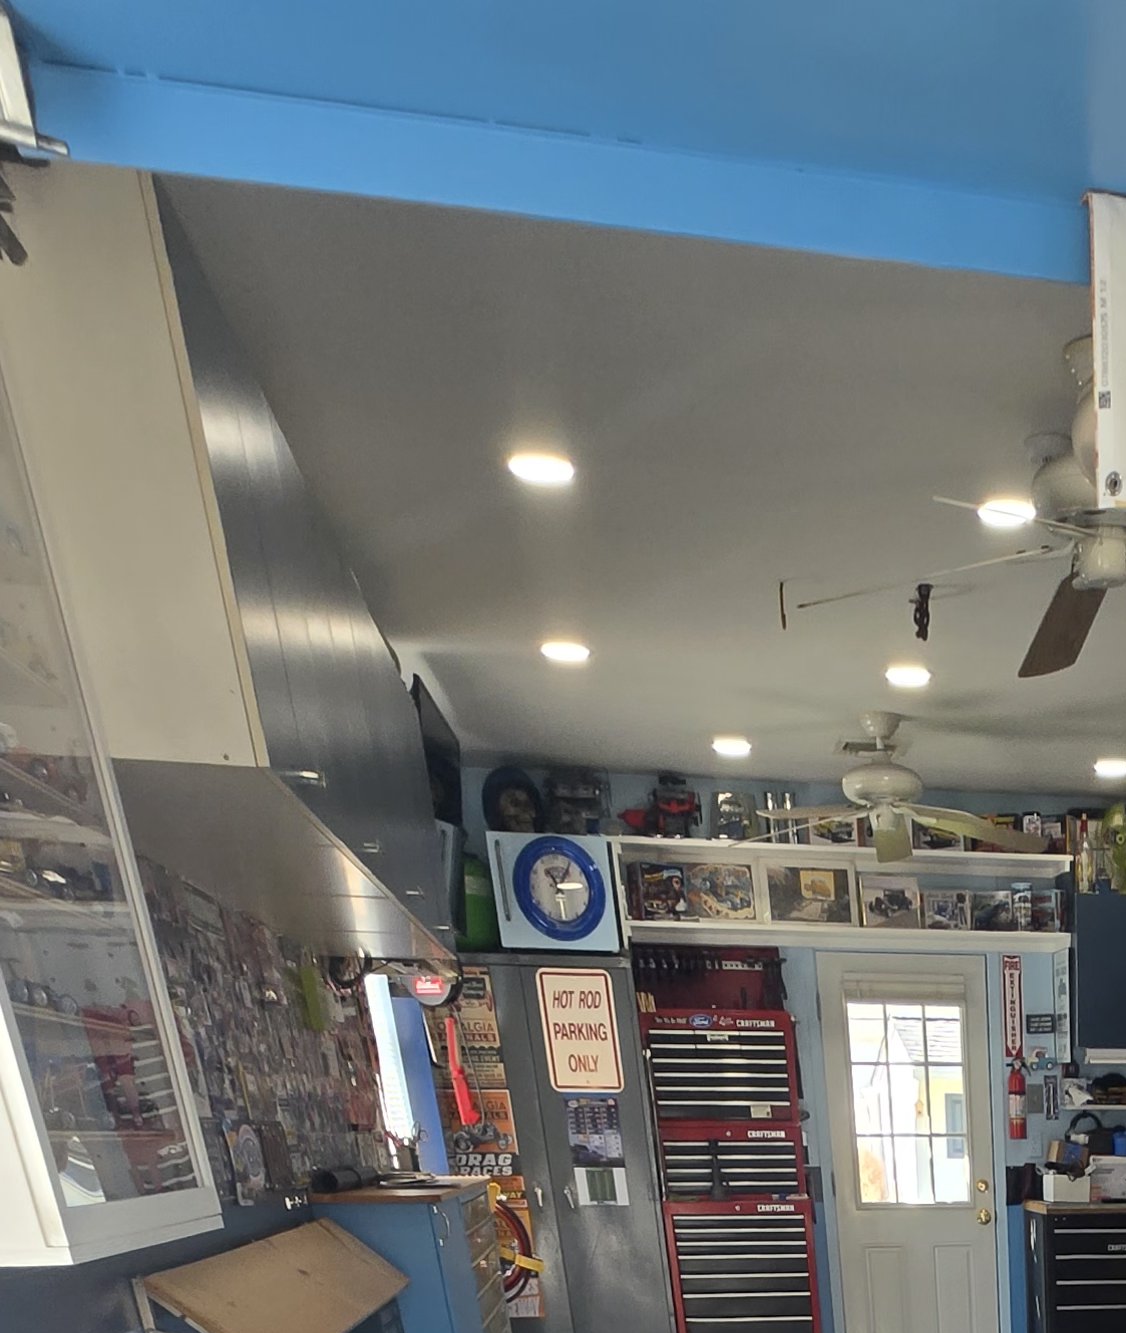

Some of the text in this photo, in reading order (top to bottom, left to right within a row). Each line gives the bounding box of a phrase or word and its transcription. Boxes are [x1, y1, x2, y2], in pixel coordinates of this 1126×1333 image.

[1003, 961, 1020, 970] FIRE
[553, 991, 602, 1009] HOT ROD
[736, 1019, 775, 1028] CRAFTSMAN
[553, 1022, 608, 1041] PARKING
[568, 1054, 599, 1073] ONLY
[456, 1153, 513, 1166] DRAG
[460, 1166, 513, 1176] RACES
